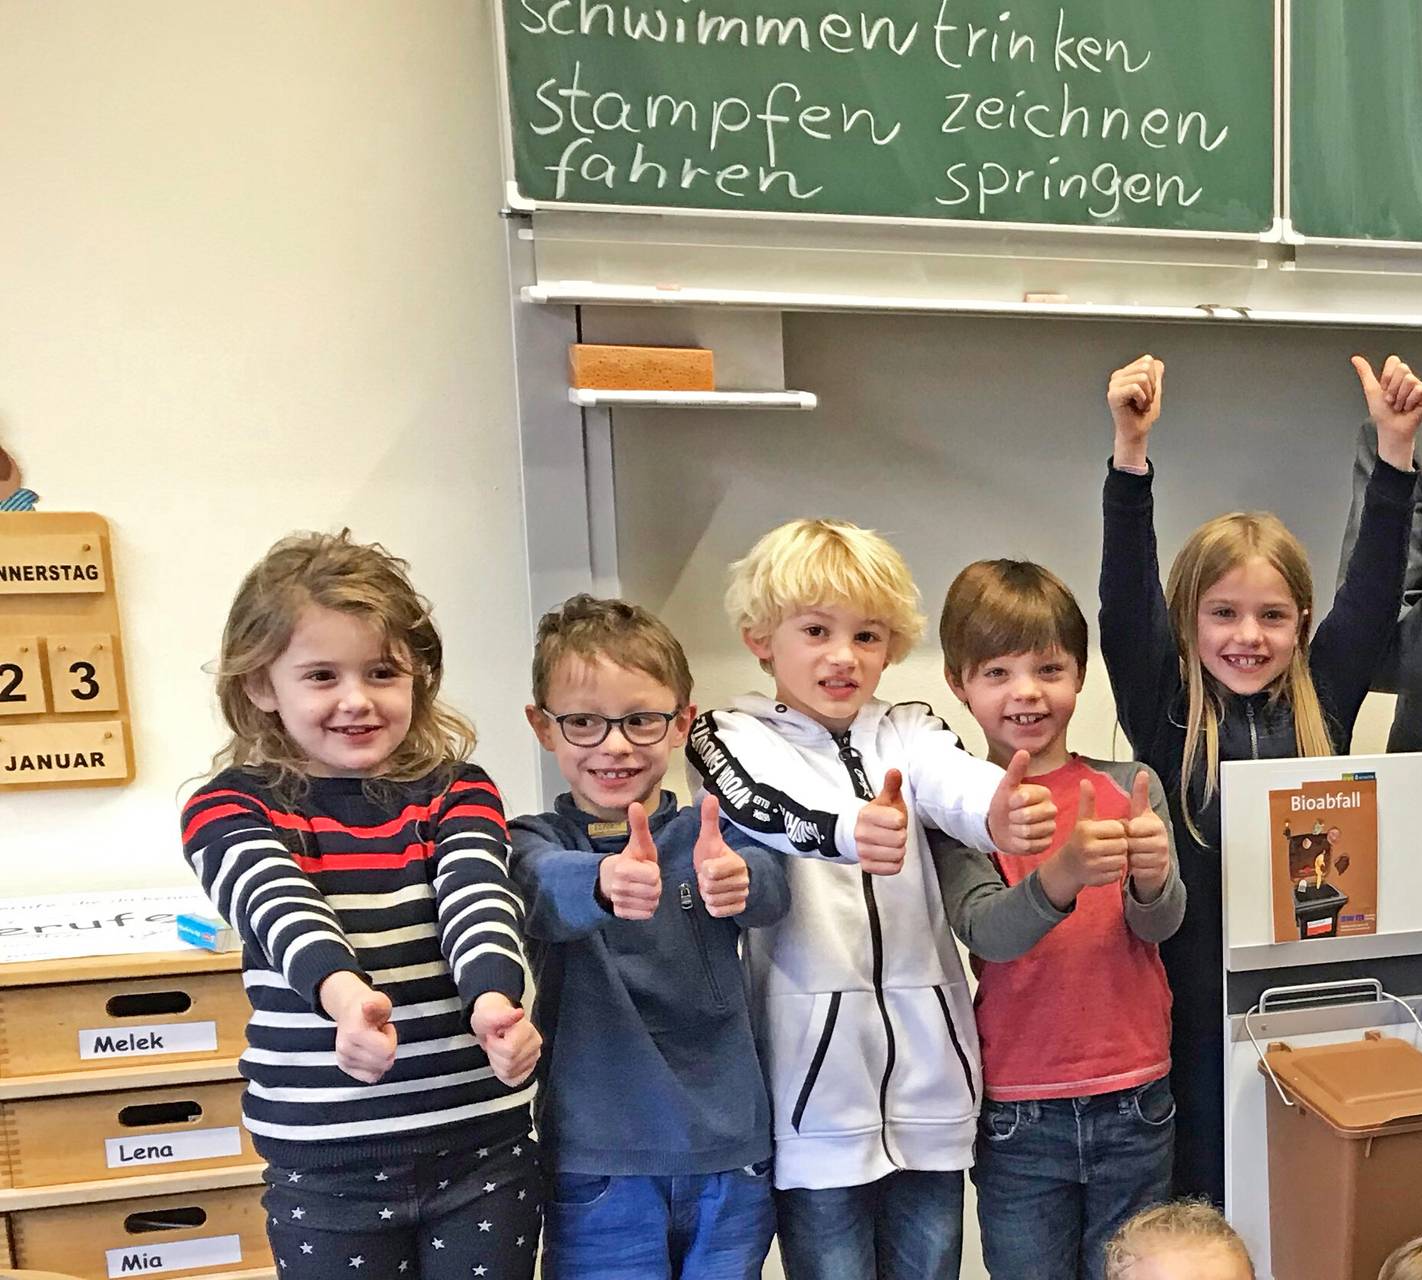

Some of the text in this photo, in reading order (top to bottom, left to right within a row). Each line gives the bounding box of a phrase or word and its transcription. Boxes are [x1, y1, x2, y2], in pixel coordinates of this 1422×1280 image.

[520, 0, 918, 55] schwimmen
[934, 0, 1150, 72] trinken
[530, 61, 900, 168] stampfen
[942, 83, 1228, 151] zeichnen
[545, 138, 823, 200] fahren
[936, 157, 1202, 218] springen
[0, 661, 100, 702] 2 3
[5, 752, 106, 772] JANUAR
[1291, 791, 1361, 811] Bioabfall
[94, 1031, 164, 1054] Melek
[119, 1143, 173, 1163] Lena
[121, 1251, 163, 1272] Mia
